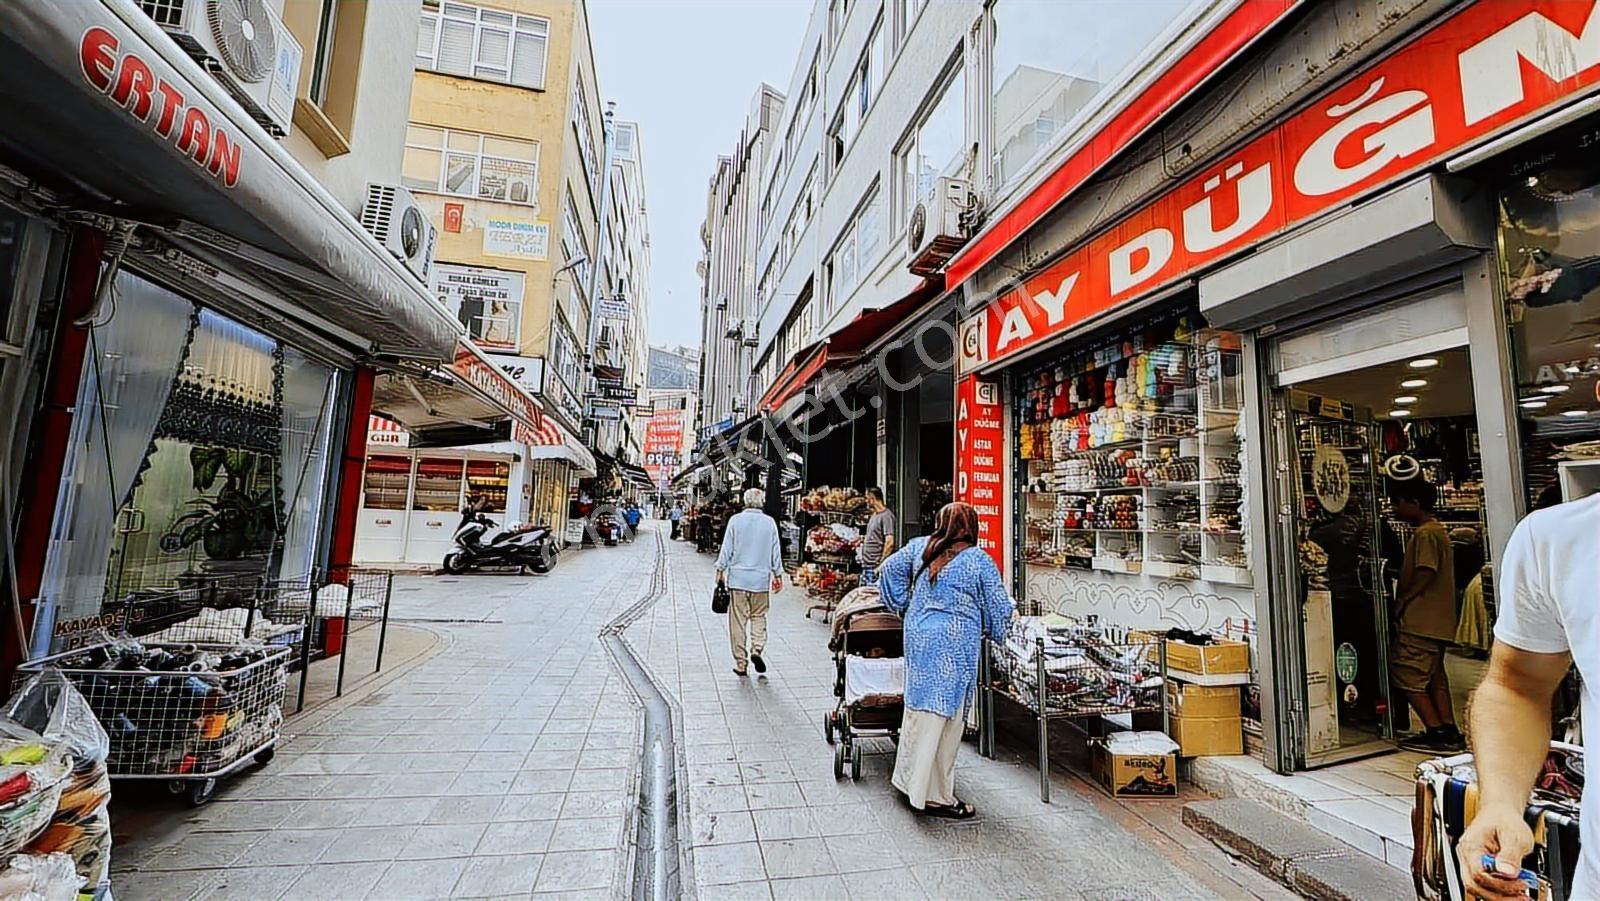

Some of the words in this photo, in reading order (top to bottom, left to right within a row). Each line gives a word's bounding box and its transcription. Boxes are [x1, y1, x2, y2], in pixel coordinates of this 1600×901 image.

[80, 26, 242, 188] ERTAN
[996, 273, 1080, 353] AY
[981, 407, 993, 416] AY
